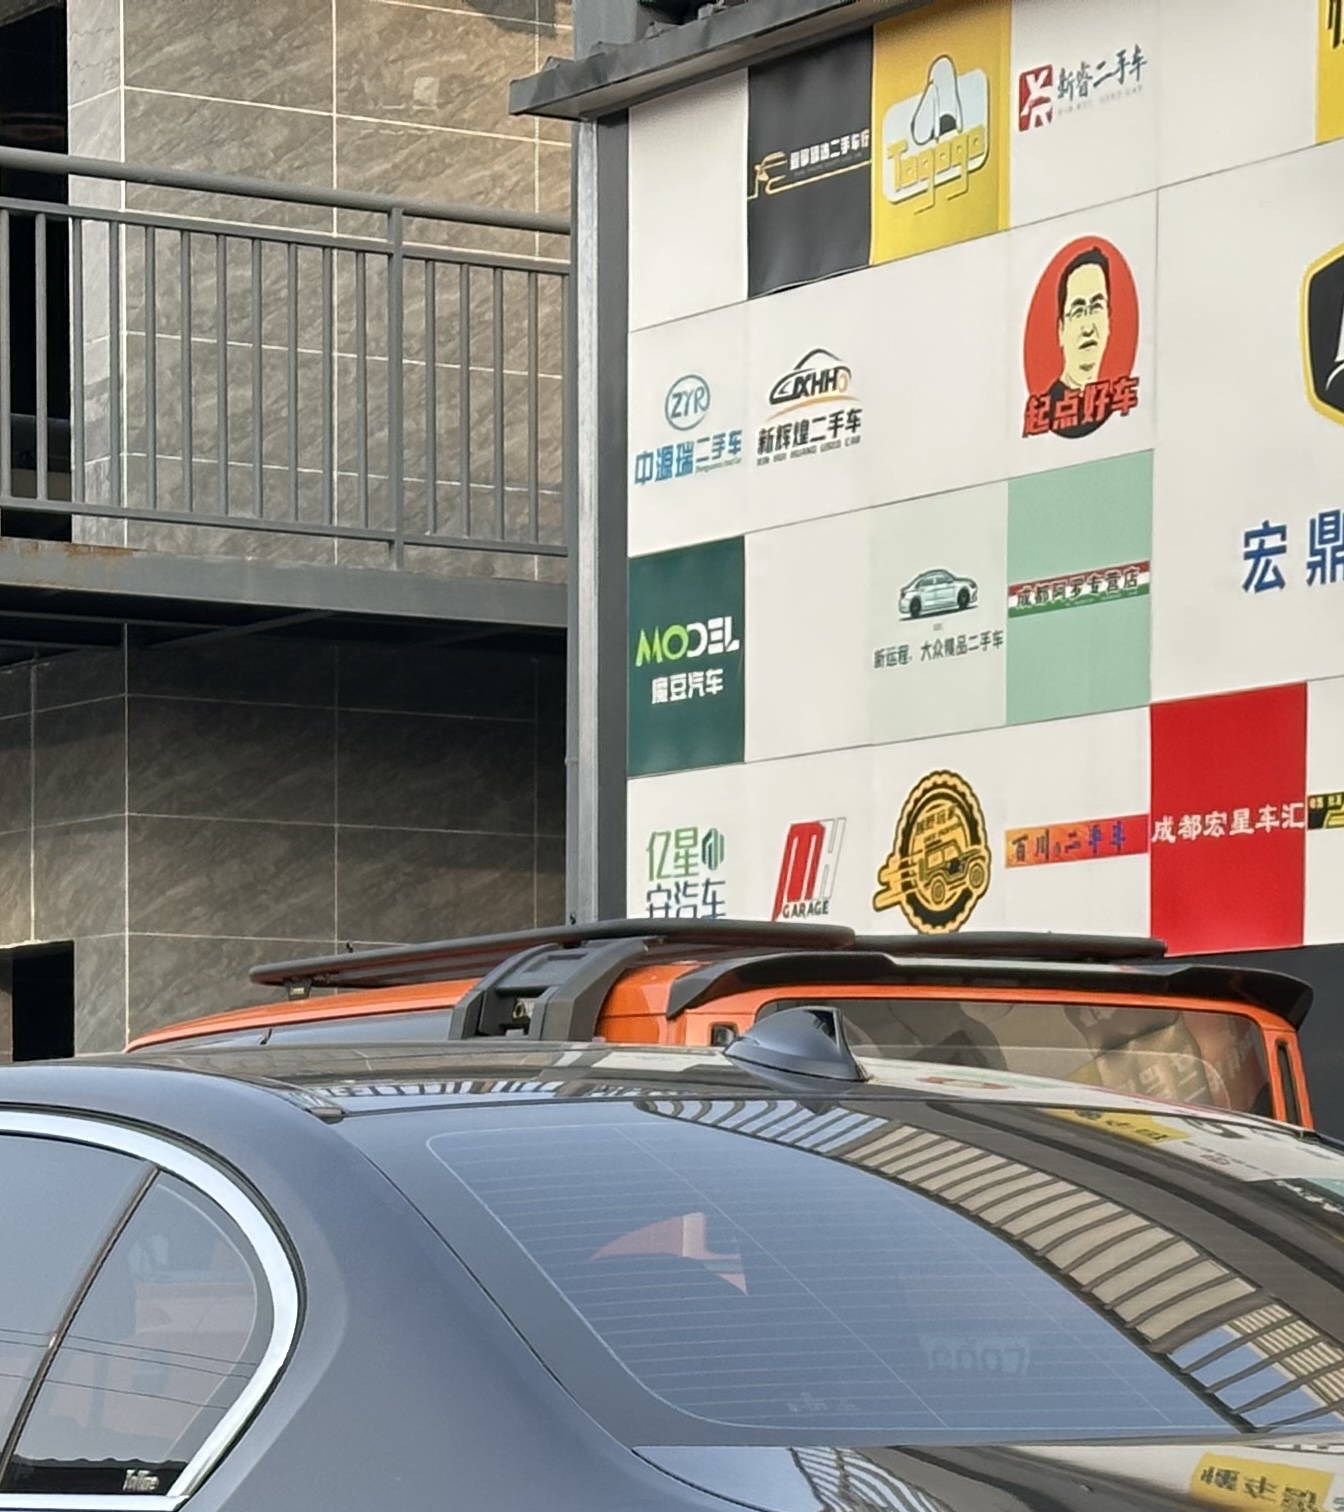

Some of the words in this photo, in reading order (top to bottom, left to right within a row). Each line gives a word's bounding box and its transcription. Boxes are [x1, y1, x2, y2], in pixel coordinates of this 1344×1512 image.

[1022, 376, 1140, 438] 起点好车
[757, 408, 862, 455] 新辉煌二手车
[1152, 802, 1304, 843] 成都宏星车汇
[646, 827, 699, 881] 亿星
[782, 900, 829, 919] GARAGE
